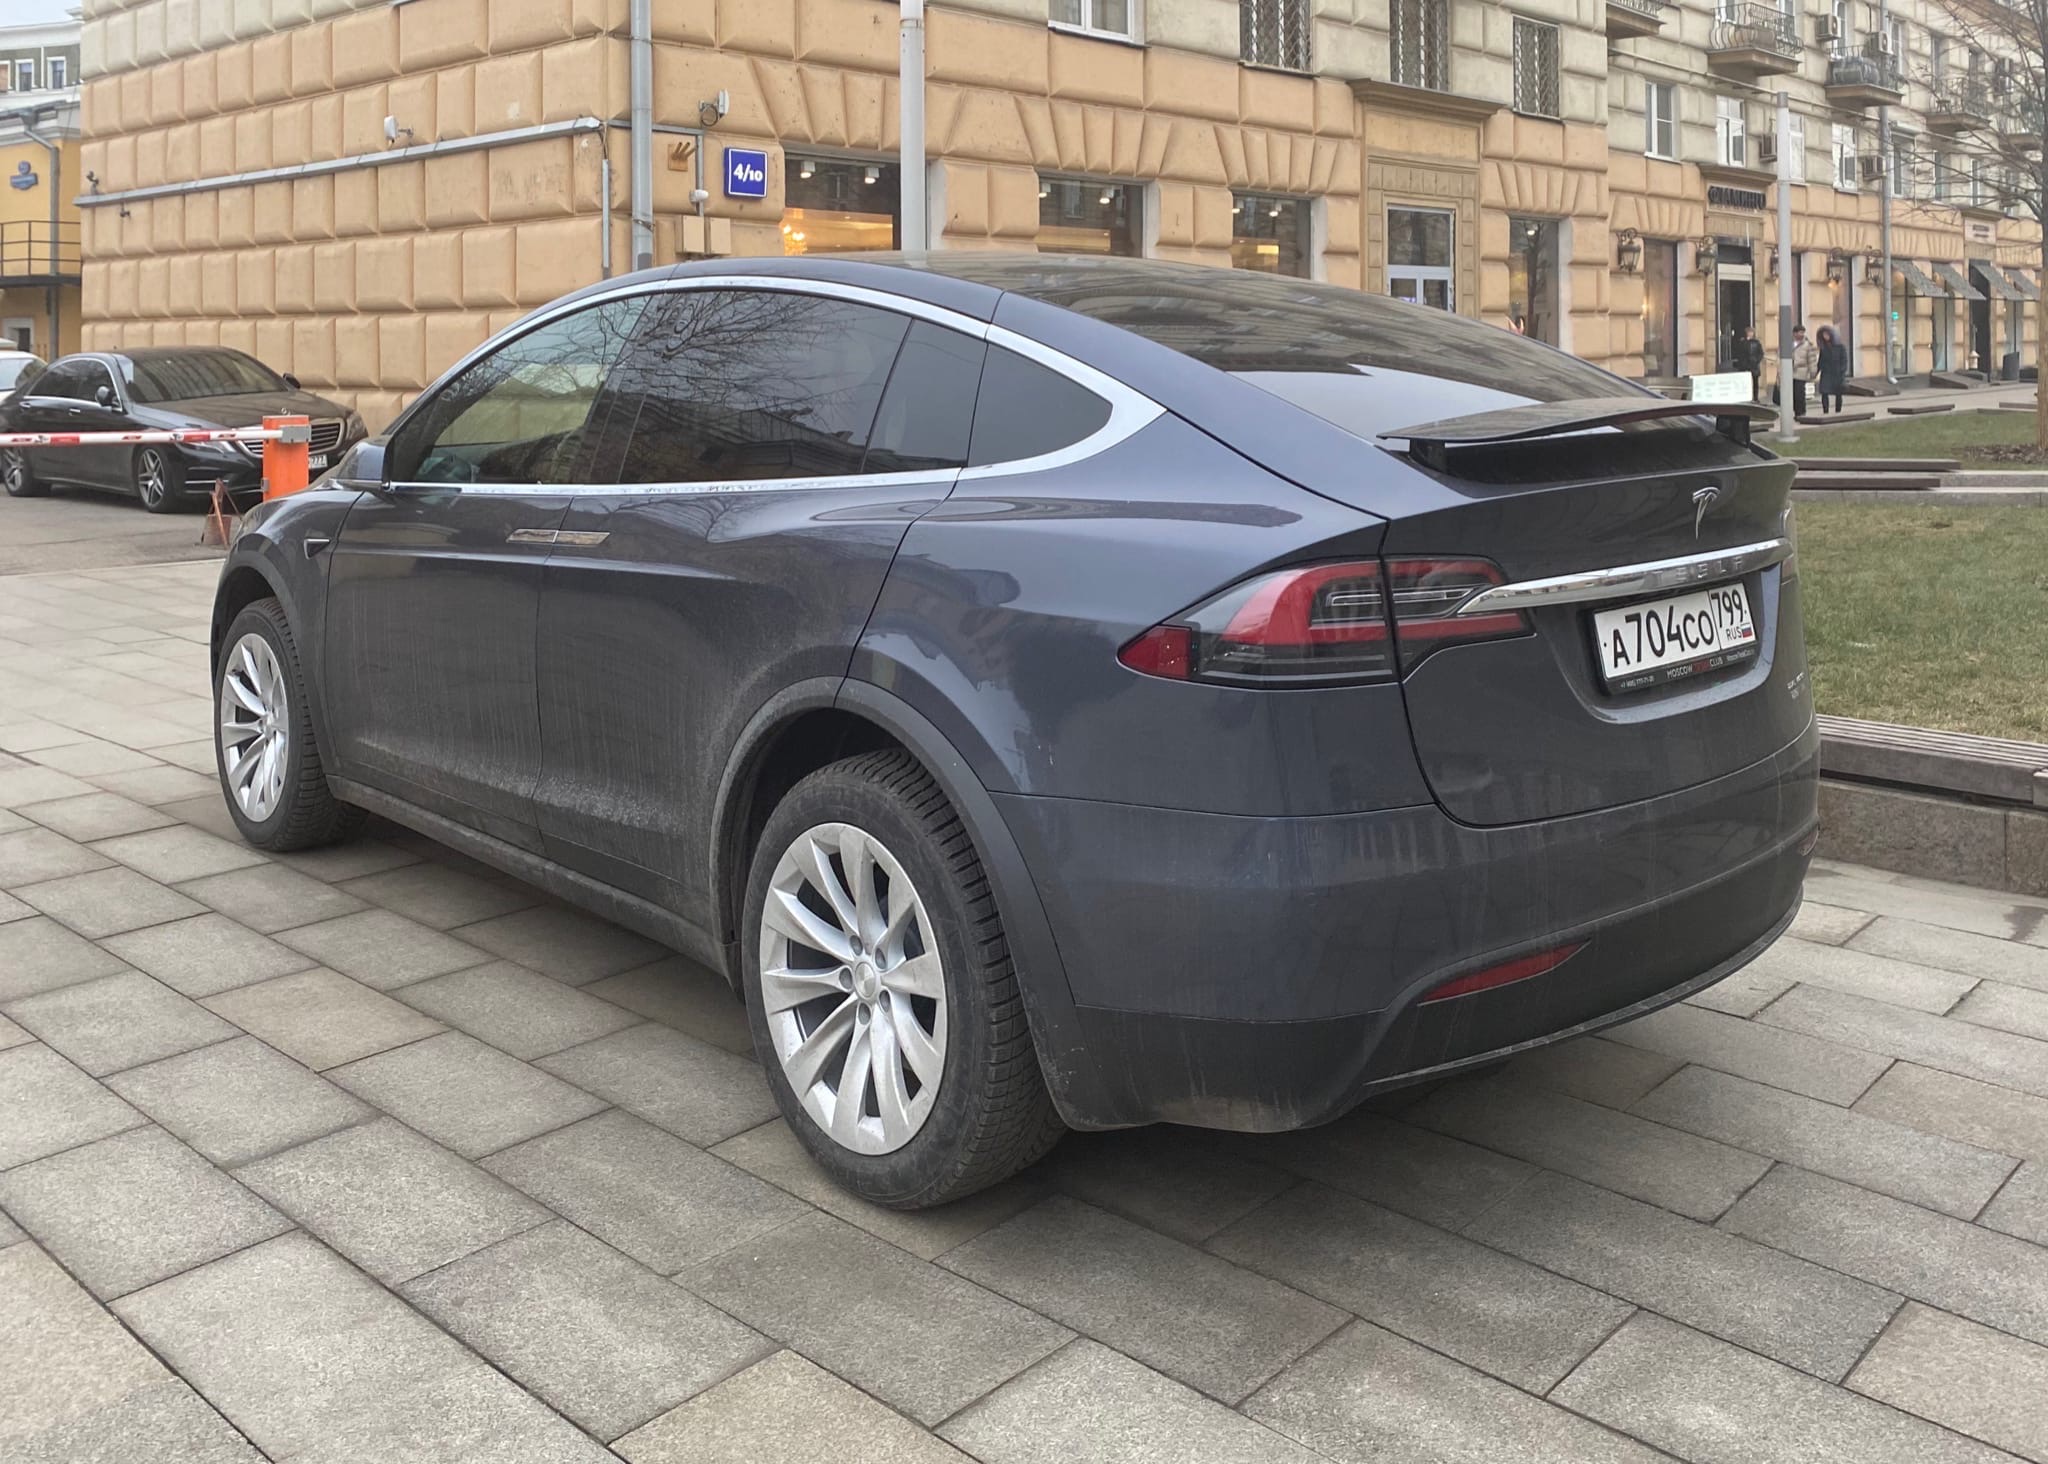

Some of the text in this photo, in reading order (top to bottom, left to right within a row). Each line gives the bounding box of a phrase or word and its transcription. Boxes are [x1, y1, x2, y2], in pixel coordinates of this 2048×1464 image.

[733, 163, 763, 182] 4/10
[1710, 589, 1743, 628] 799
[1726, 626, 1742, 641] RUS
[1666, 664, 1693, 679] MOSCOW
